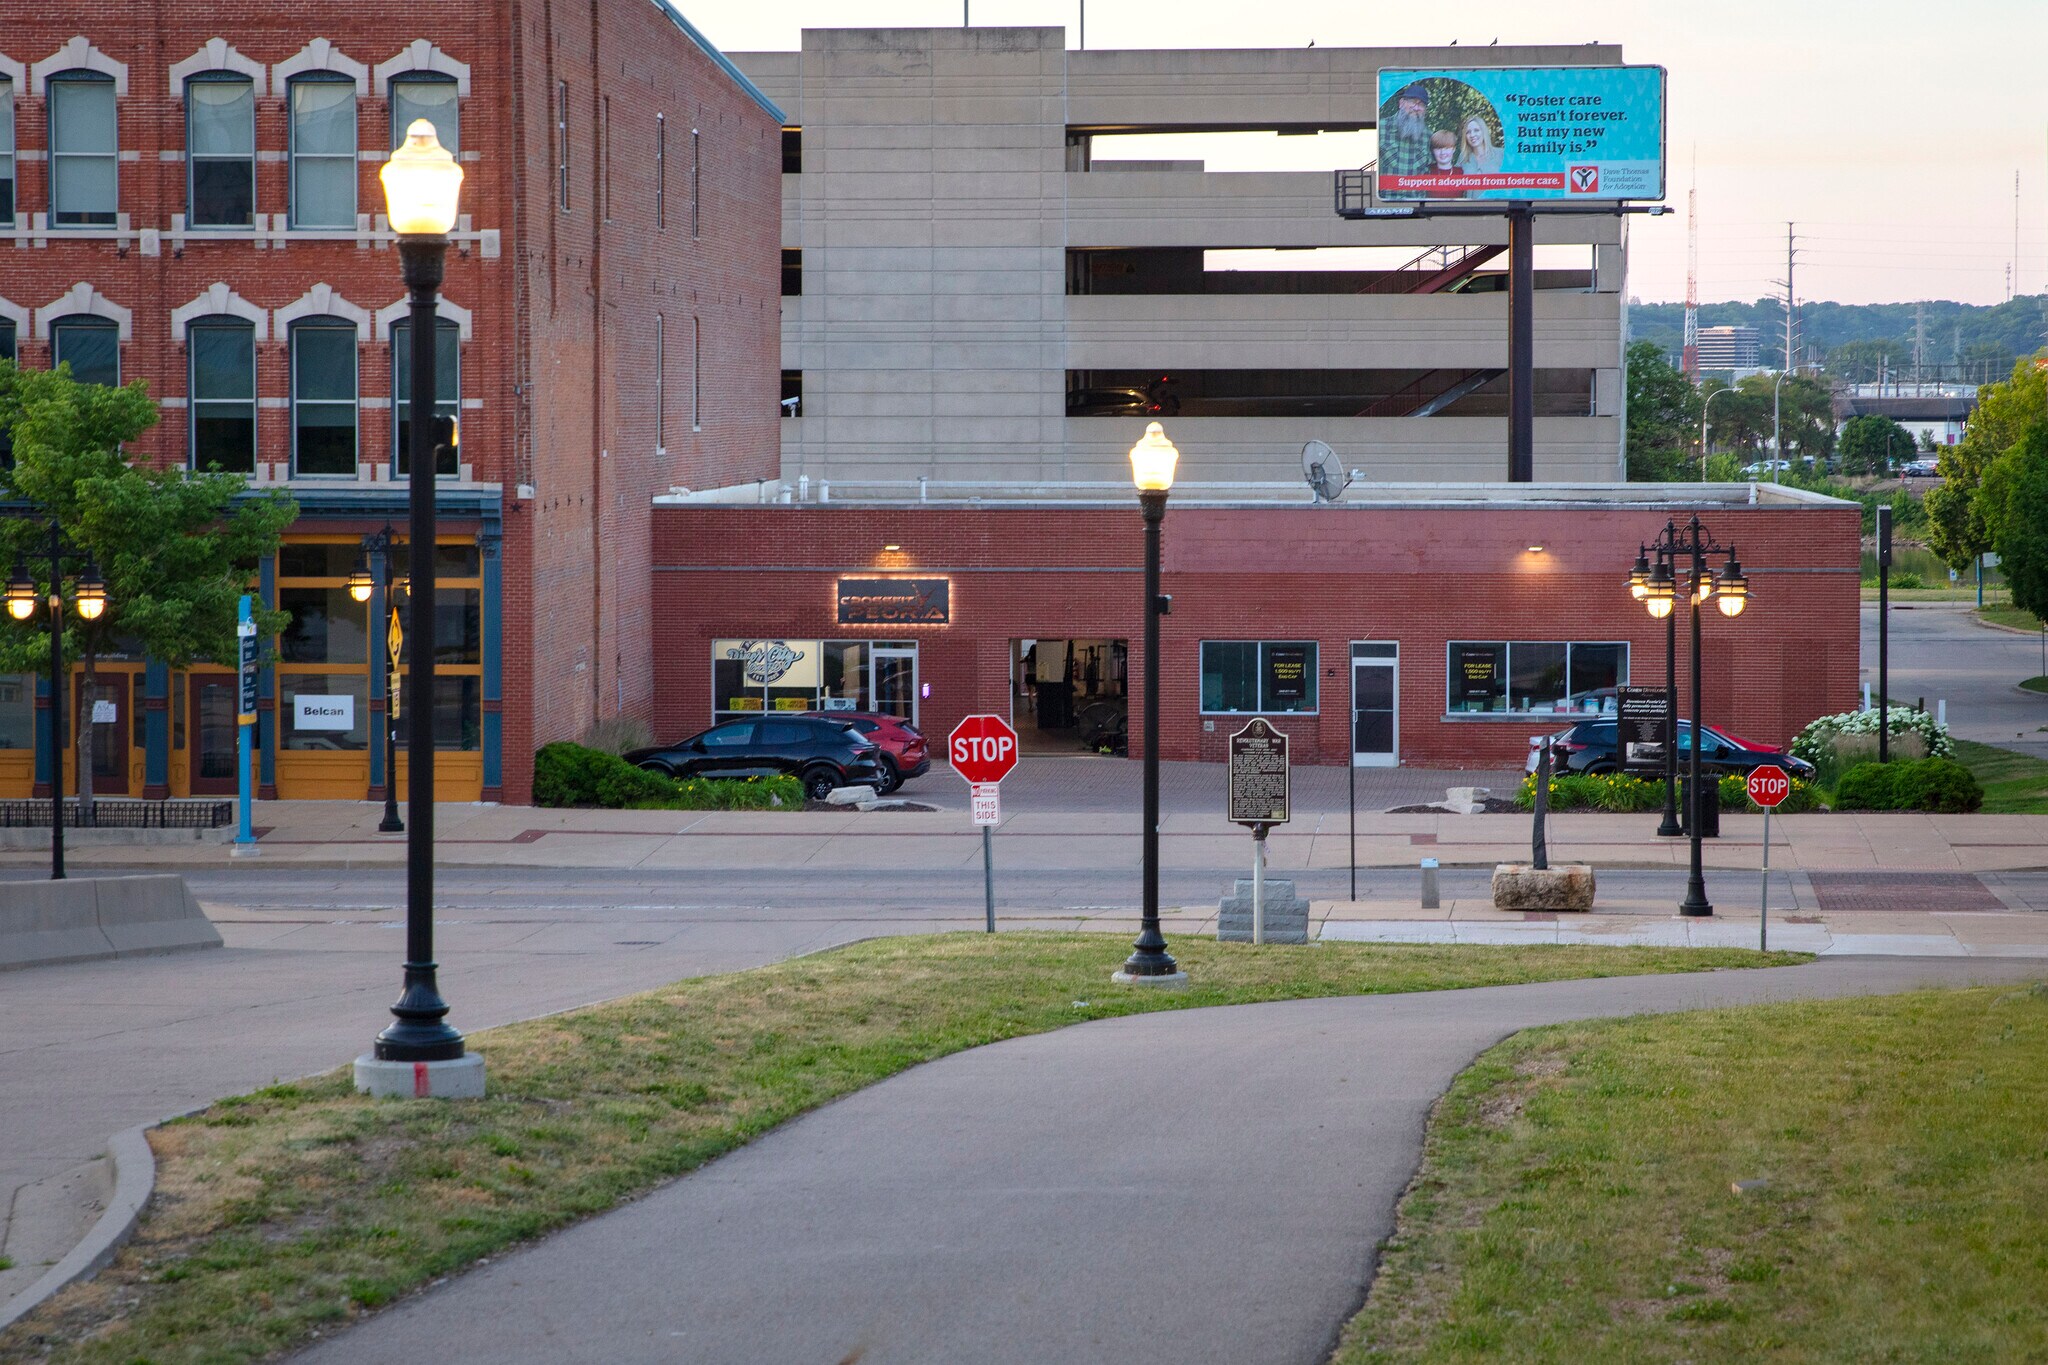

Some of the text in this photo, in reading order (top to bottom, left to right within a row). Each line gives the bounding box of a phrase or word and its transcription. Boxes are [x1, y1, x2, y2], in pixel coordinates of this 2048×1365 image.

[1506, 94, 1602, 106] “Foster care
[1517, 110, 1627, 121] wasn't forever.
[1517, 126, 1605, 139] But my new
[1517, 140, 1597, 155] family is.”
[1398, 174, 1561, 187] Support adoption from foster care.
[1614, 182, 1646, 190] Adoption
[304, 706, 344, 716] Belcan
[954, 736, 1013, 762] STOP
[1750, 778, 1787, 794] STOP
[976, 801, 996, 809] THIS
[976, 812, 997, 820] SIDE
